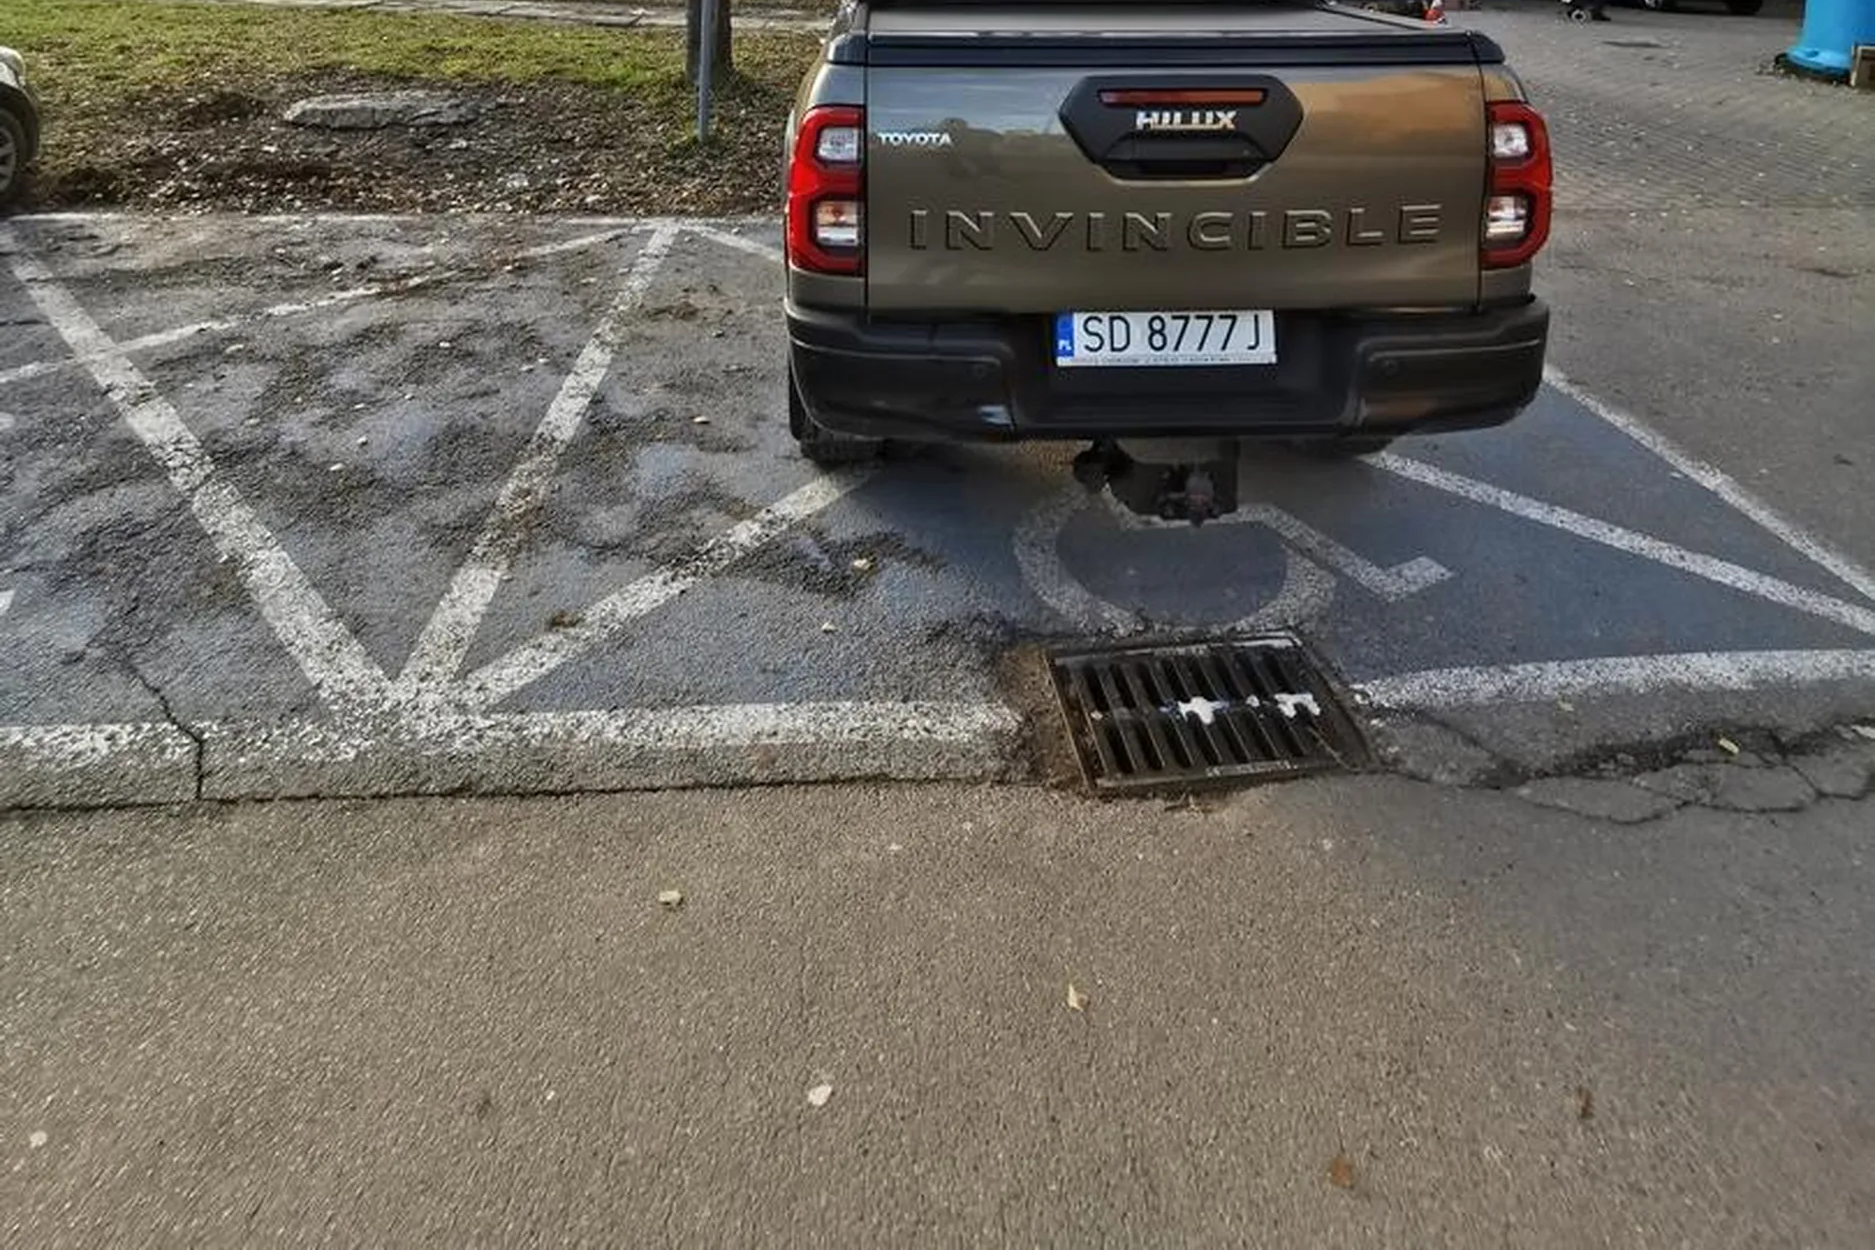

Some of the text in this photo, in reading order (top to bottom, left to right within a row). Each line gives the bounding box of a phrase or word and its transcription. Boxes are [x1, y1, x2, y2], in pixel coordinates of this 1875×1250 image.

[1136, 110, 1237, 131] HILUX
[877, 132, 952, 147] TOYOTA
[909, 203, 1443, 252] INVINCIBLE
[1082, 315, 1131, 353] SD
